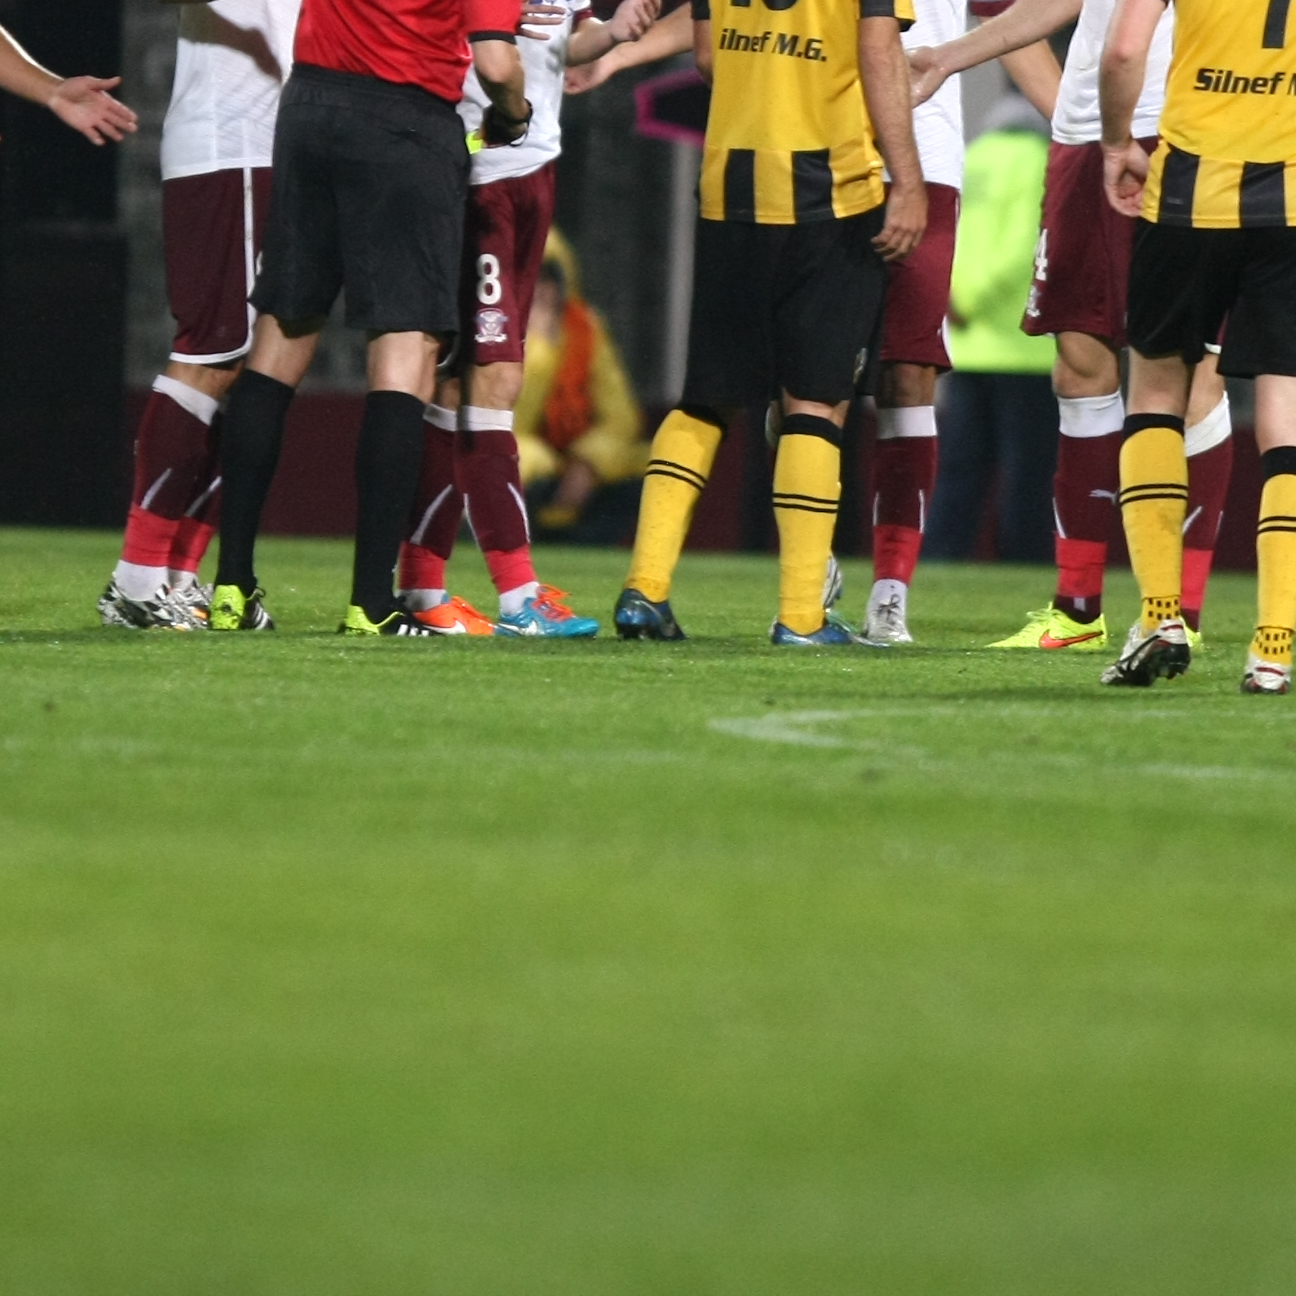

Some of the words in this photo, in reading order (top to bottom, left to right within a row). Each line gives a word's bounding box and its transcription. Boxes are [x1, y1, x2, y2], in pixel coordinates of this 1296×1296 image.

[772, 32, 828, 62] M.G.
[1194, 68, 1286, 95] Silnef
[476, 253, 502, 304] 8
